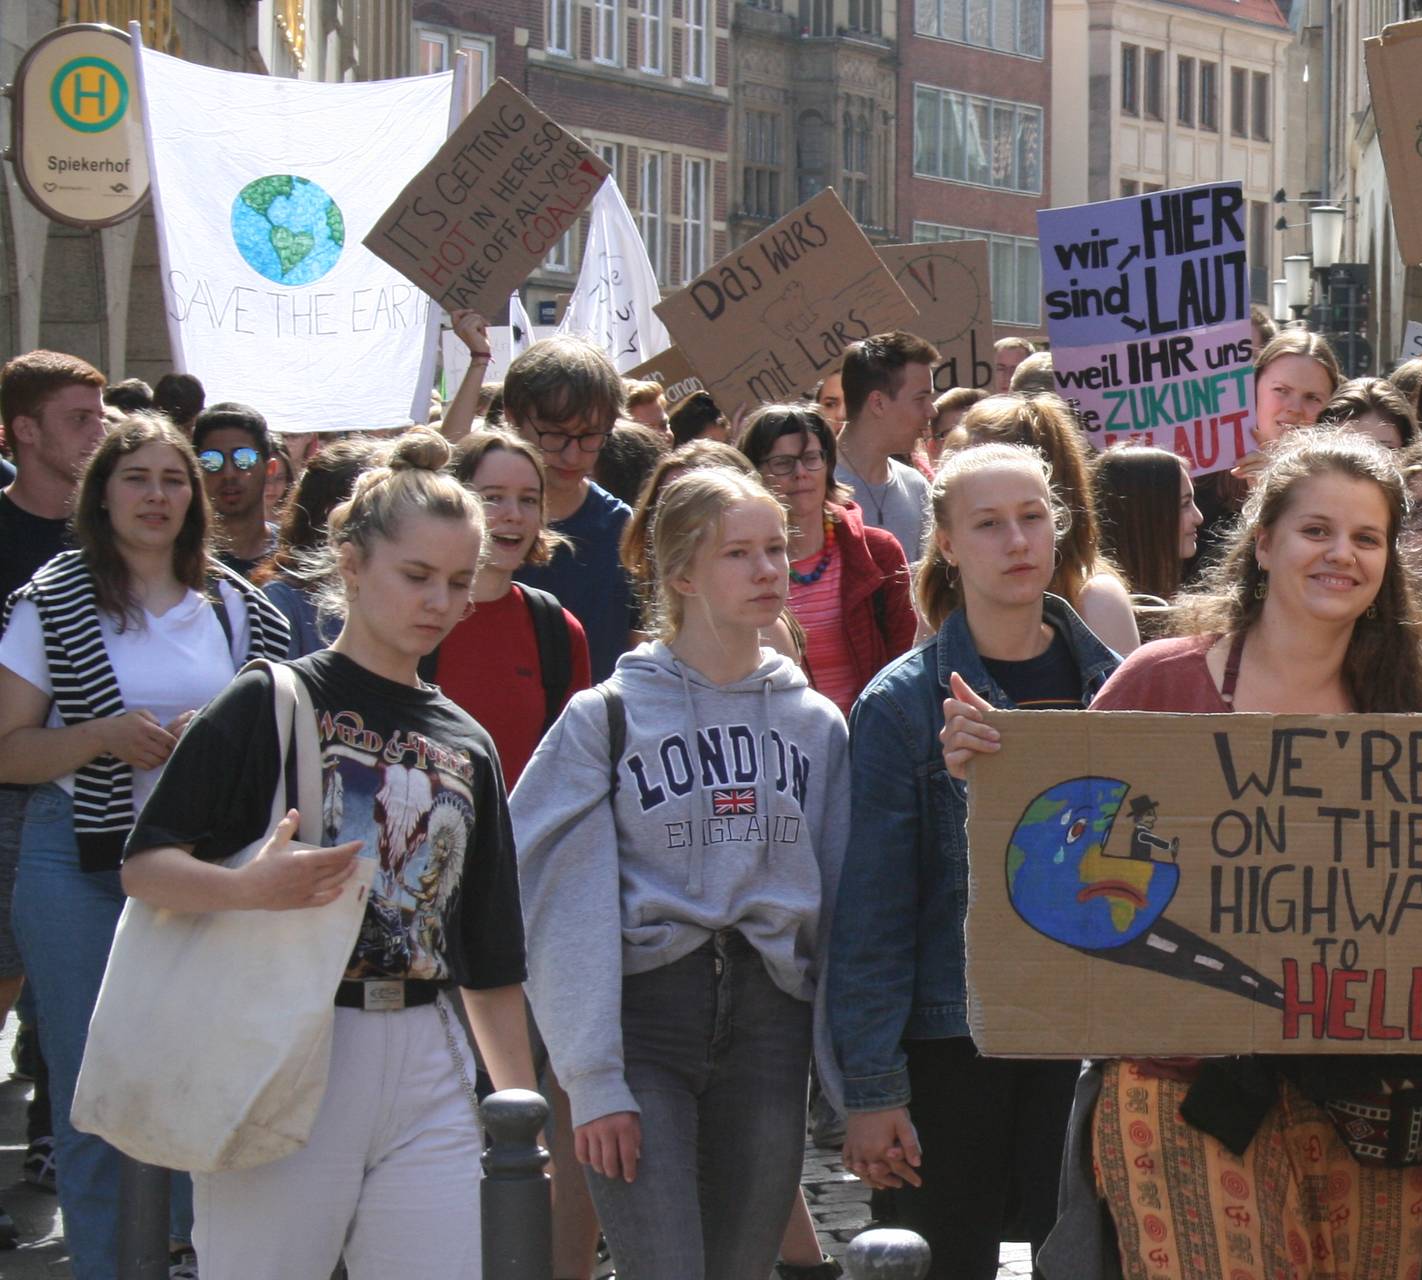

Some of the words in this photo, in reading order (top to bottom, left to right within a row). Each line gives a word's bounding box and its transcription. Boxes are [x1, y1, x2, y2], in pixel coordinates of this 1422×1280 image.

[74, 73, 107, 116] H
[47, 155, 132, 173] Spiekerhof
[434, 104, 527, 206] GETTING
[419, 220, 476, 288] HOT
[469, 204, 497, 231] IN
[440, 260, 492, 310] TAKE
[483, 218, 519, 264] OFF
[515, 189, 549, 227] ALL
[538, 141, 590, 189] YOUR
[1053, 228, 1120, 271] wir
[1140, 186, 1245, 260] HIER
[167, 270, 259, 335] SAVE
[266, 291, 338, 338] THE
[689, 256, 762, 322] Das
[1045, 272, 1131, 320] sind
[1144, 250, 1247, 336] LAUT
[745, 350, 799, 402] mit
[1053, 354, 1124, 390] weil
[1126, 335, 1198, 385] IHR
[1204, 338, 1253, 370] uns
[1102, 364, 1257, 431] ZUKUNFT
[625, 723, 811, 814] LONDON
[1210, 805, 1287, 859] ON
[1312, 937, 1359, 970] TO
